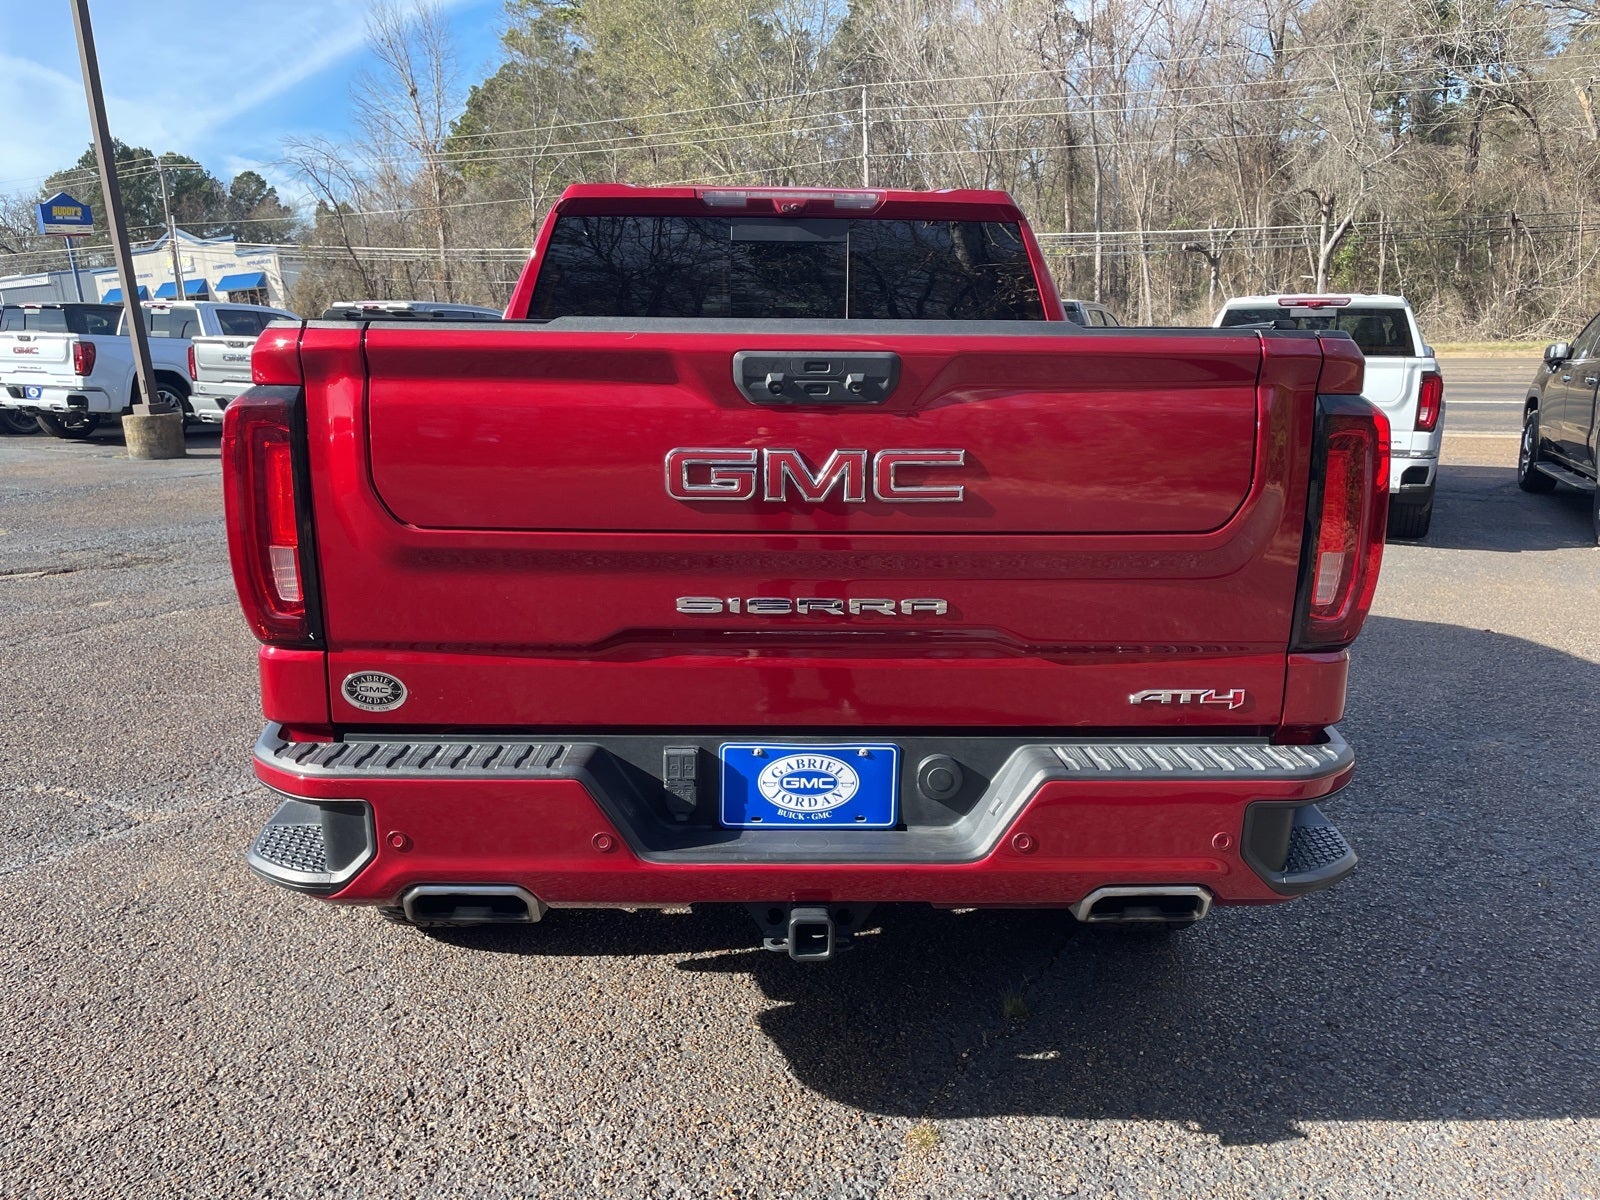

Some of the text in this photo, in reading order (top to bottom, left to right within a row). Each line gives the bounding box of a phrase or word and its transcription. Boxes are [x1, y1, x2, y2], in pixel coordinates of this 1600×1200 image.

[52, 205, 82, 216] BUDDY'S
[13, 346, 39, 354] GMC
[664, 448, 965, 502] GMC
[676, 596, 948, 616] SIERRA
[352, 675, 395, 688] GABRIEL
[359, 685, 389, 694] GMC
[352, 691, 395, 704] JORDAN
[1129, 688, 1246, 710] AT4
[771, 758, 844, 780] GABRIEL
[782, 777, 835, 789] GMC
[770, 788, 844, 808] JORDAN
[777, 808, 805, 821] BUICK
[811, 810, 832, 820] GMC
